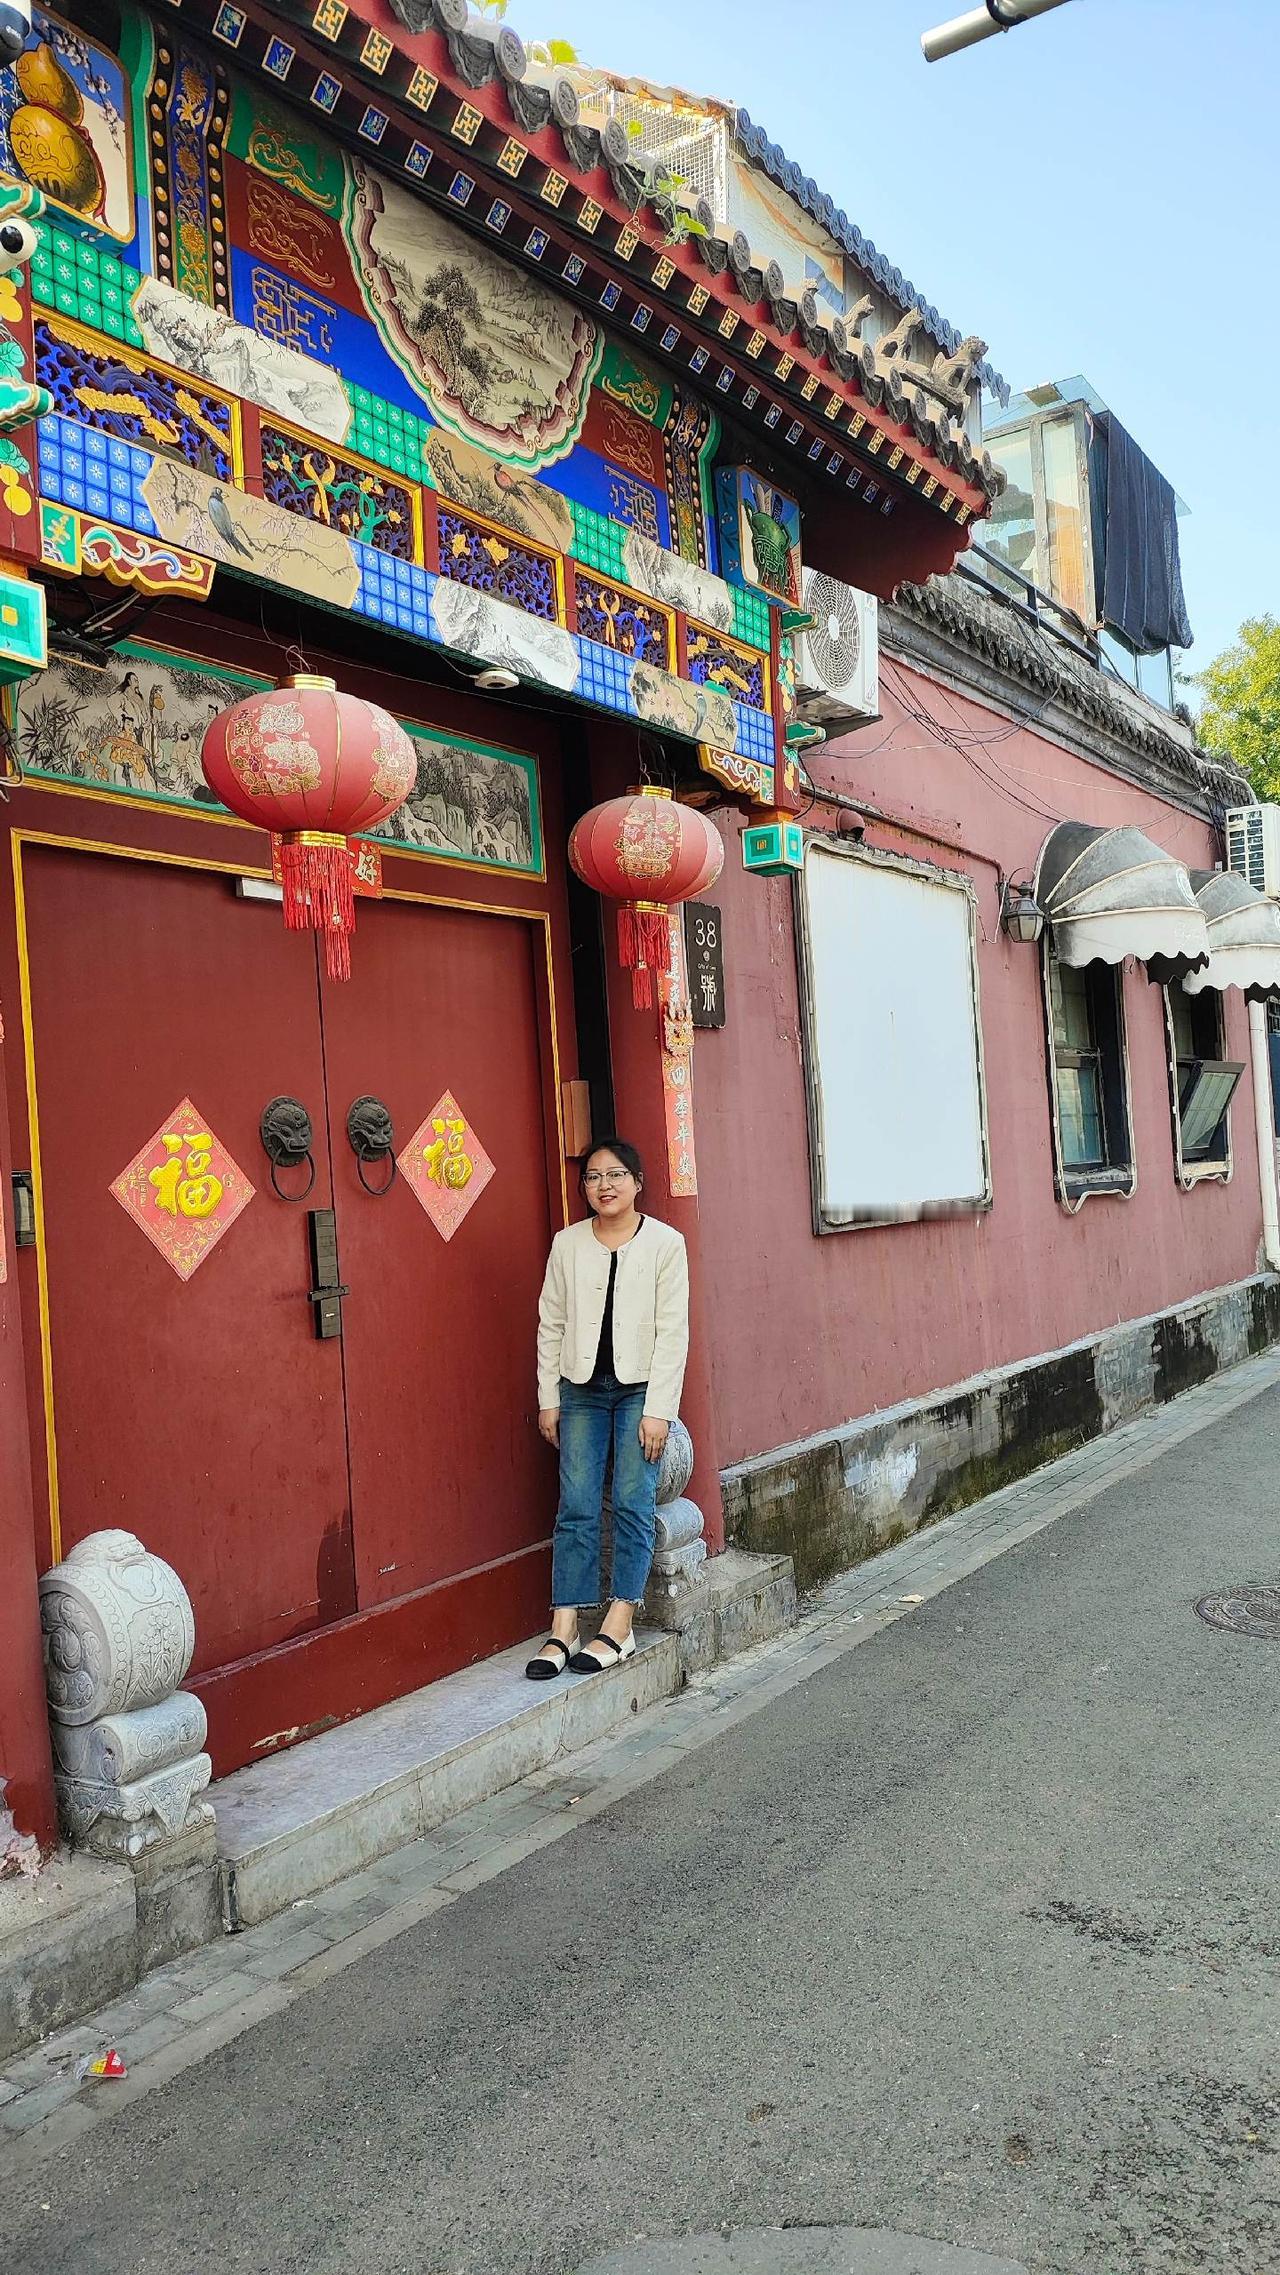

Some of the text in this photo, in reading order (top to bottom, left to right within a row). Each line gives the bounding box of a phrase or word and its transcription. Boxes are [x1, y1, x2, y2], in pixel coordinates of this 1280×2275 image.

[355, 851, 377, 886] 好
[695, 918, 717, 948] 38
[422, 1117, 474, 1191] 福
[671, 1066, 695, 1177] 四季平安
[148, 1131, 224, 1219] 福
